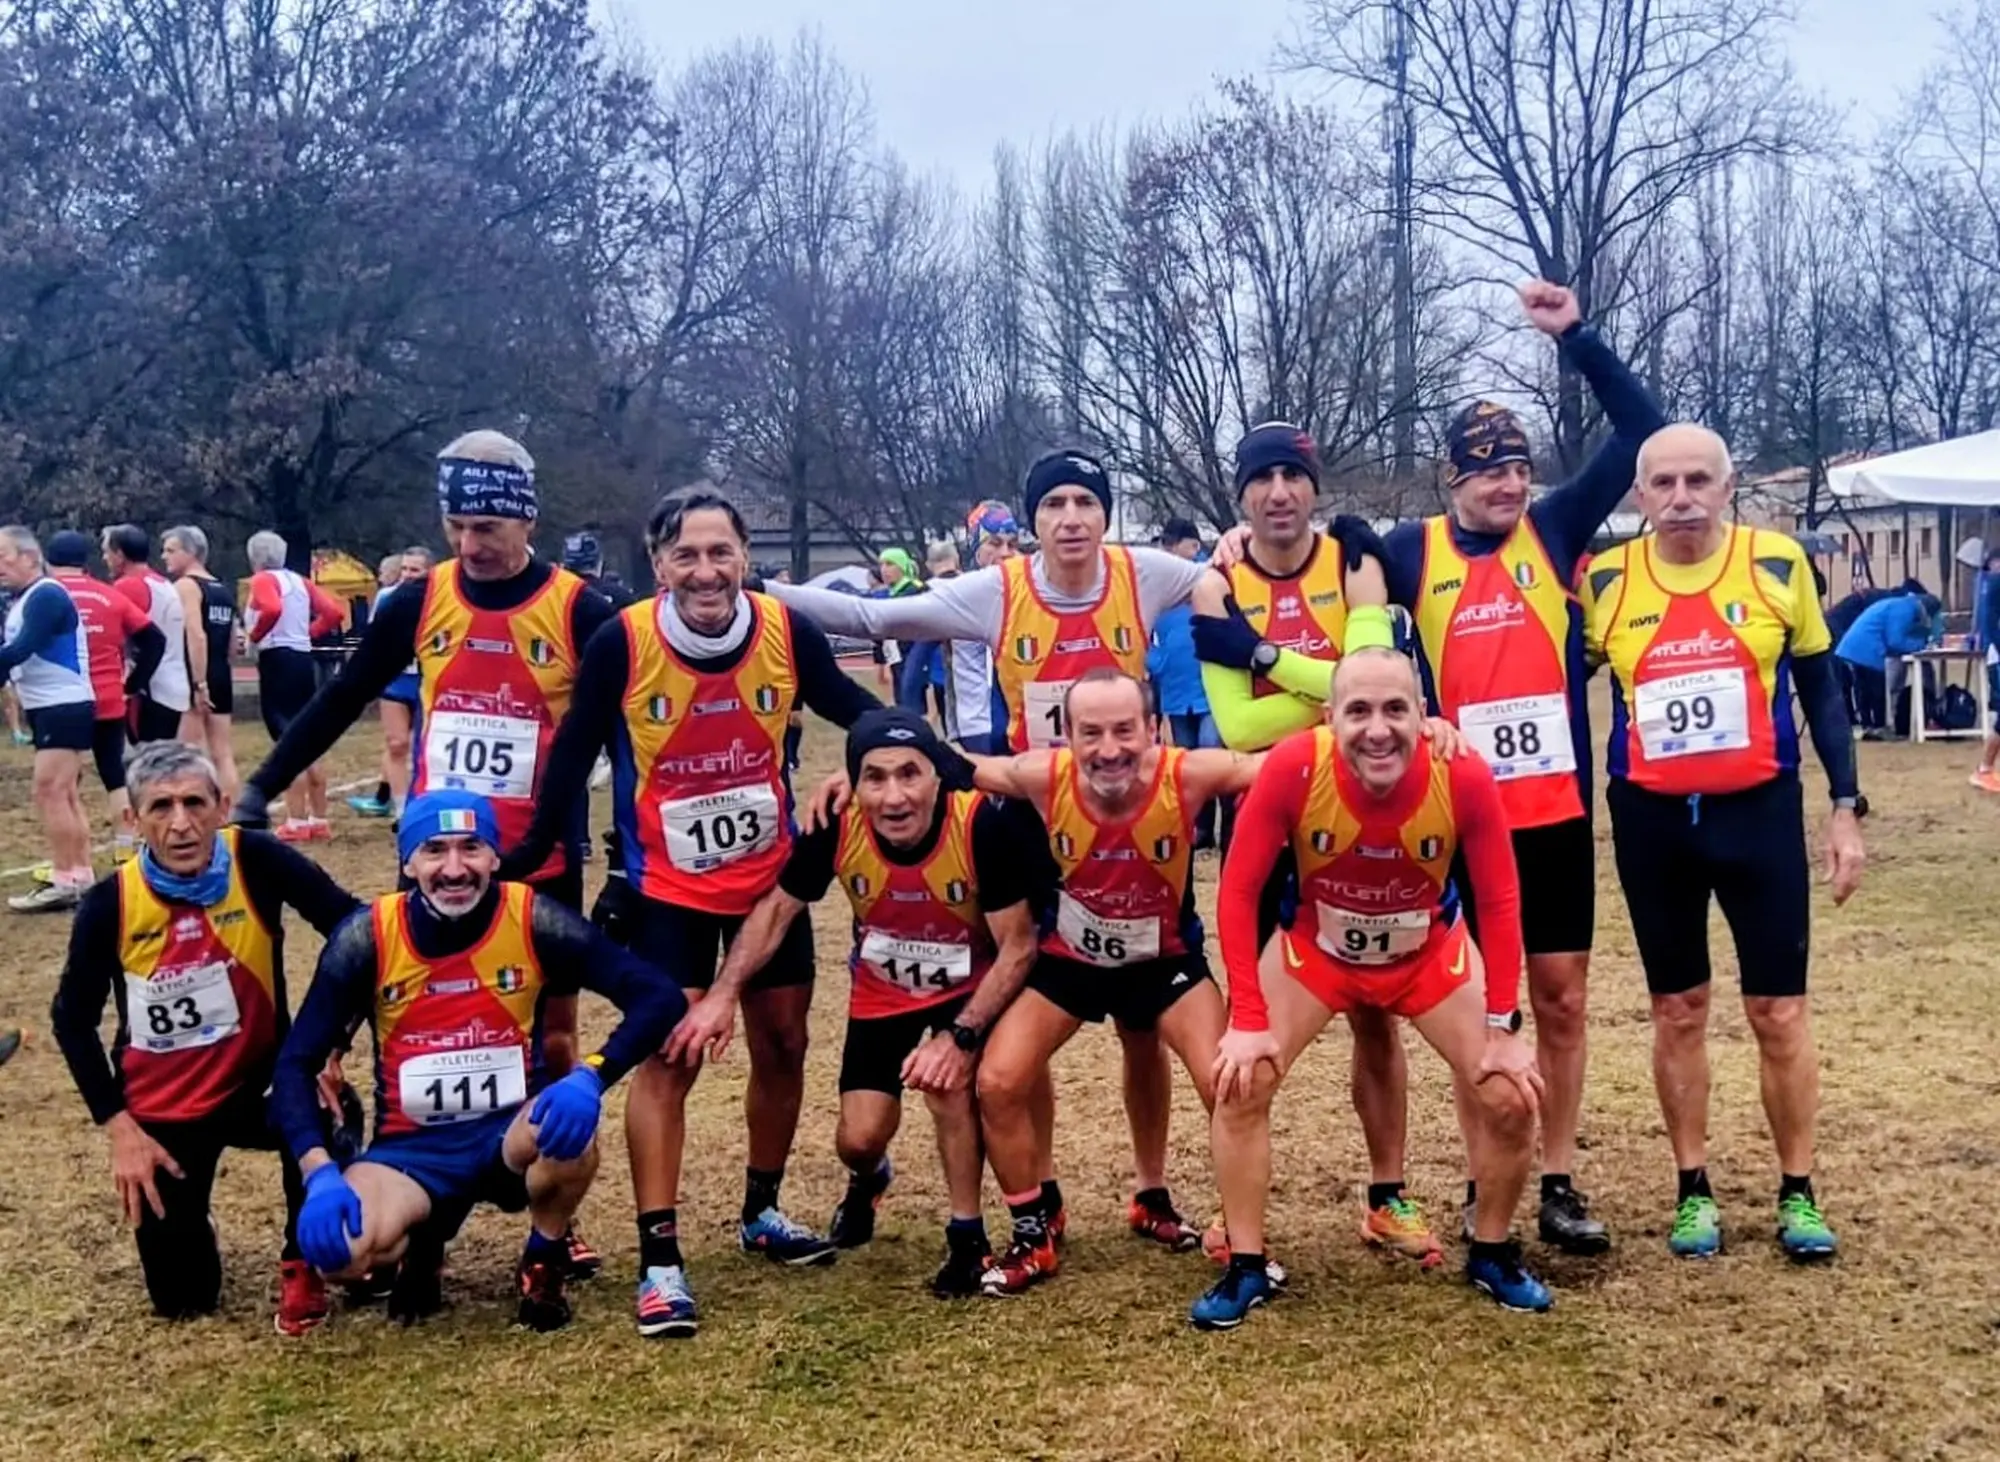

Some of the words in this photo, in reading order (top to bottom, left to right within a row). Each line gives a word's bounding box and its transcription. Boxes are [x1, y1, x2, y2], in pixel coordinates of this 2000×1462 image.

[1454, 592, 1525, 625] ATLETICA
[1648, 629, 1736, 657] ATLETICA
[1666, 696, 1717, 734] 99
[445, 737, 515, 776] 105
[658, 739, 772, 774] ATLETICA
[1494, 721, 1541, 759] 88
[687, 810, 761, 853] 103
[1082, 910, 1131, 930] TLETICA
[1082, 928, 1126, 960] 86
[1345, 929, 1391, 952] 91
[143, 975, 195, 995] TLETICA
[881, 958, 952, 988] 114
[148, 997, 203, 1035] 83
[425, 1074, 500, 1112] 111
